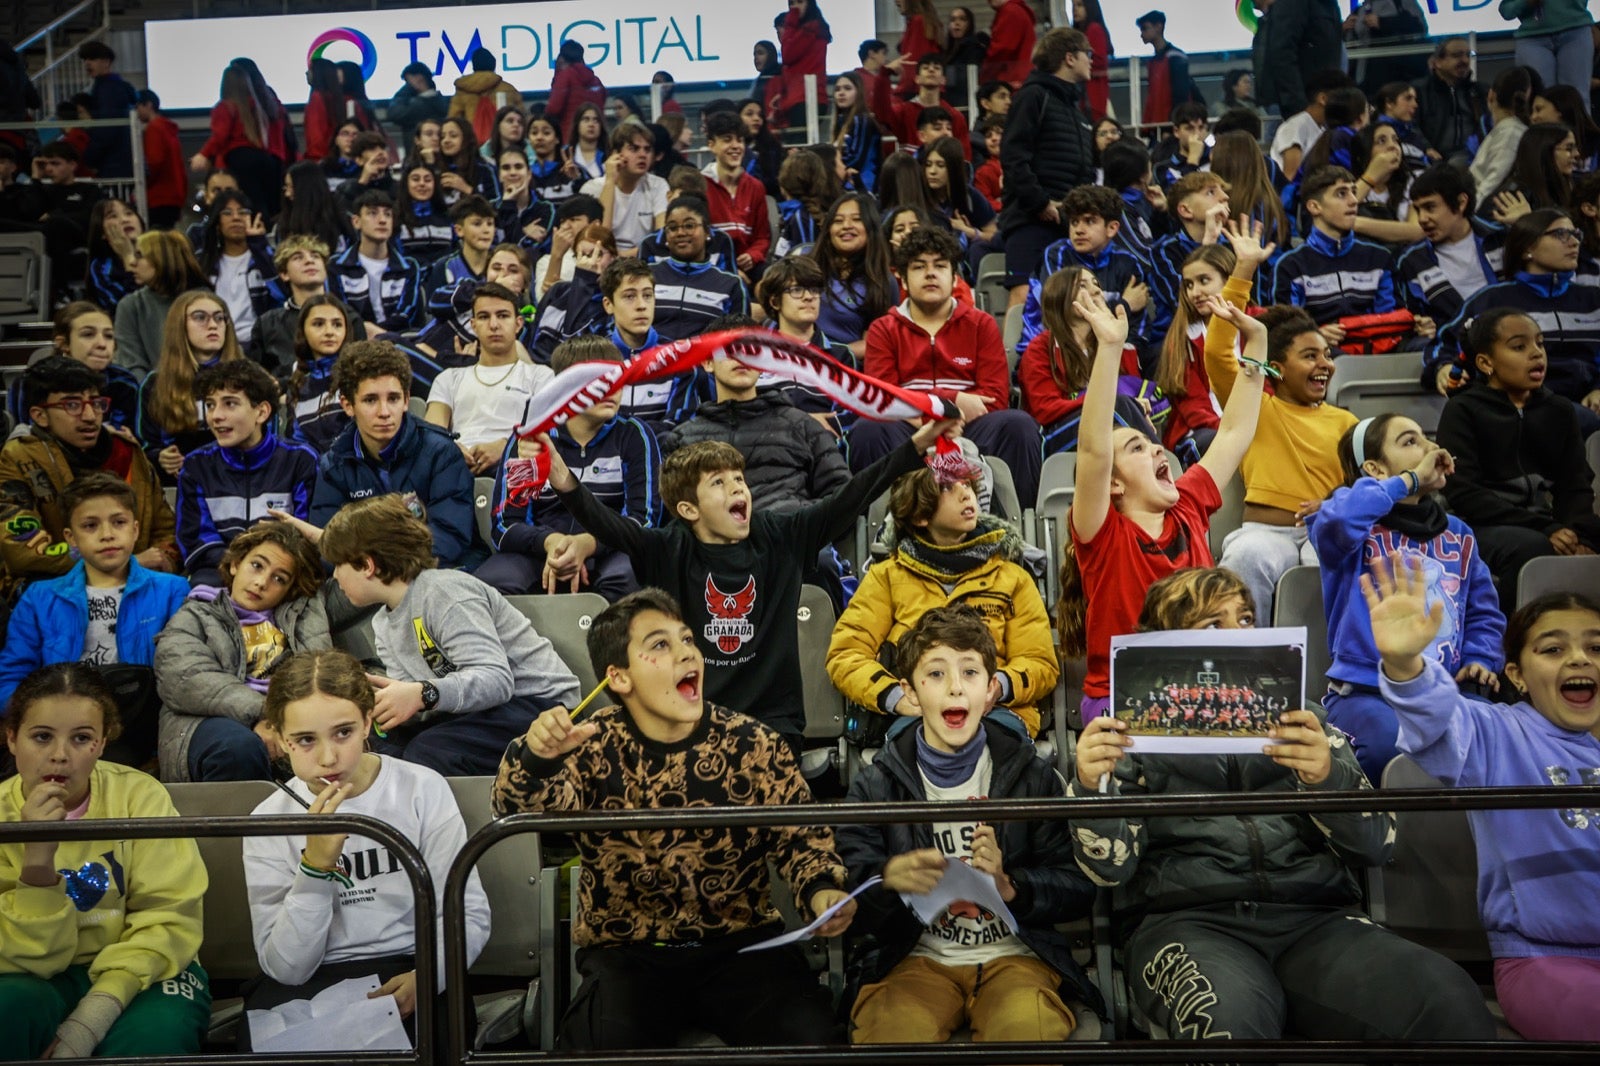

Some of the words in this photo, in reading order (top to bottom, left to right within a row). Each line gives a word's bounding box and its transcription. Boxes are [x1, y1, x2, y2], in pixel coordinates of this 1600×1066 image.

[501, 14, 720, 72] DIGITAL
[706, 626, 752, 637] GRANADA
[716, 659, 729, 667] por
[925, 919, 1012, 946] ASKETBAL
[162, 980, 195, 1001] 89
